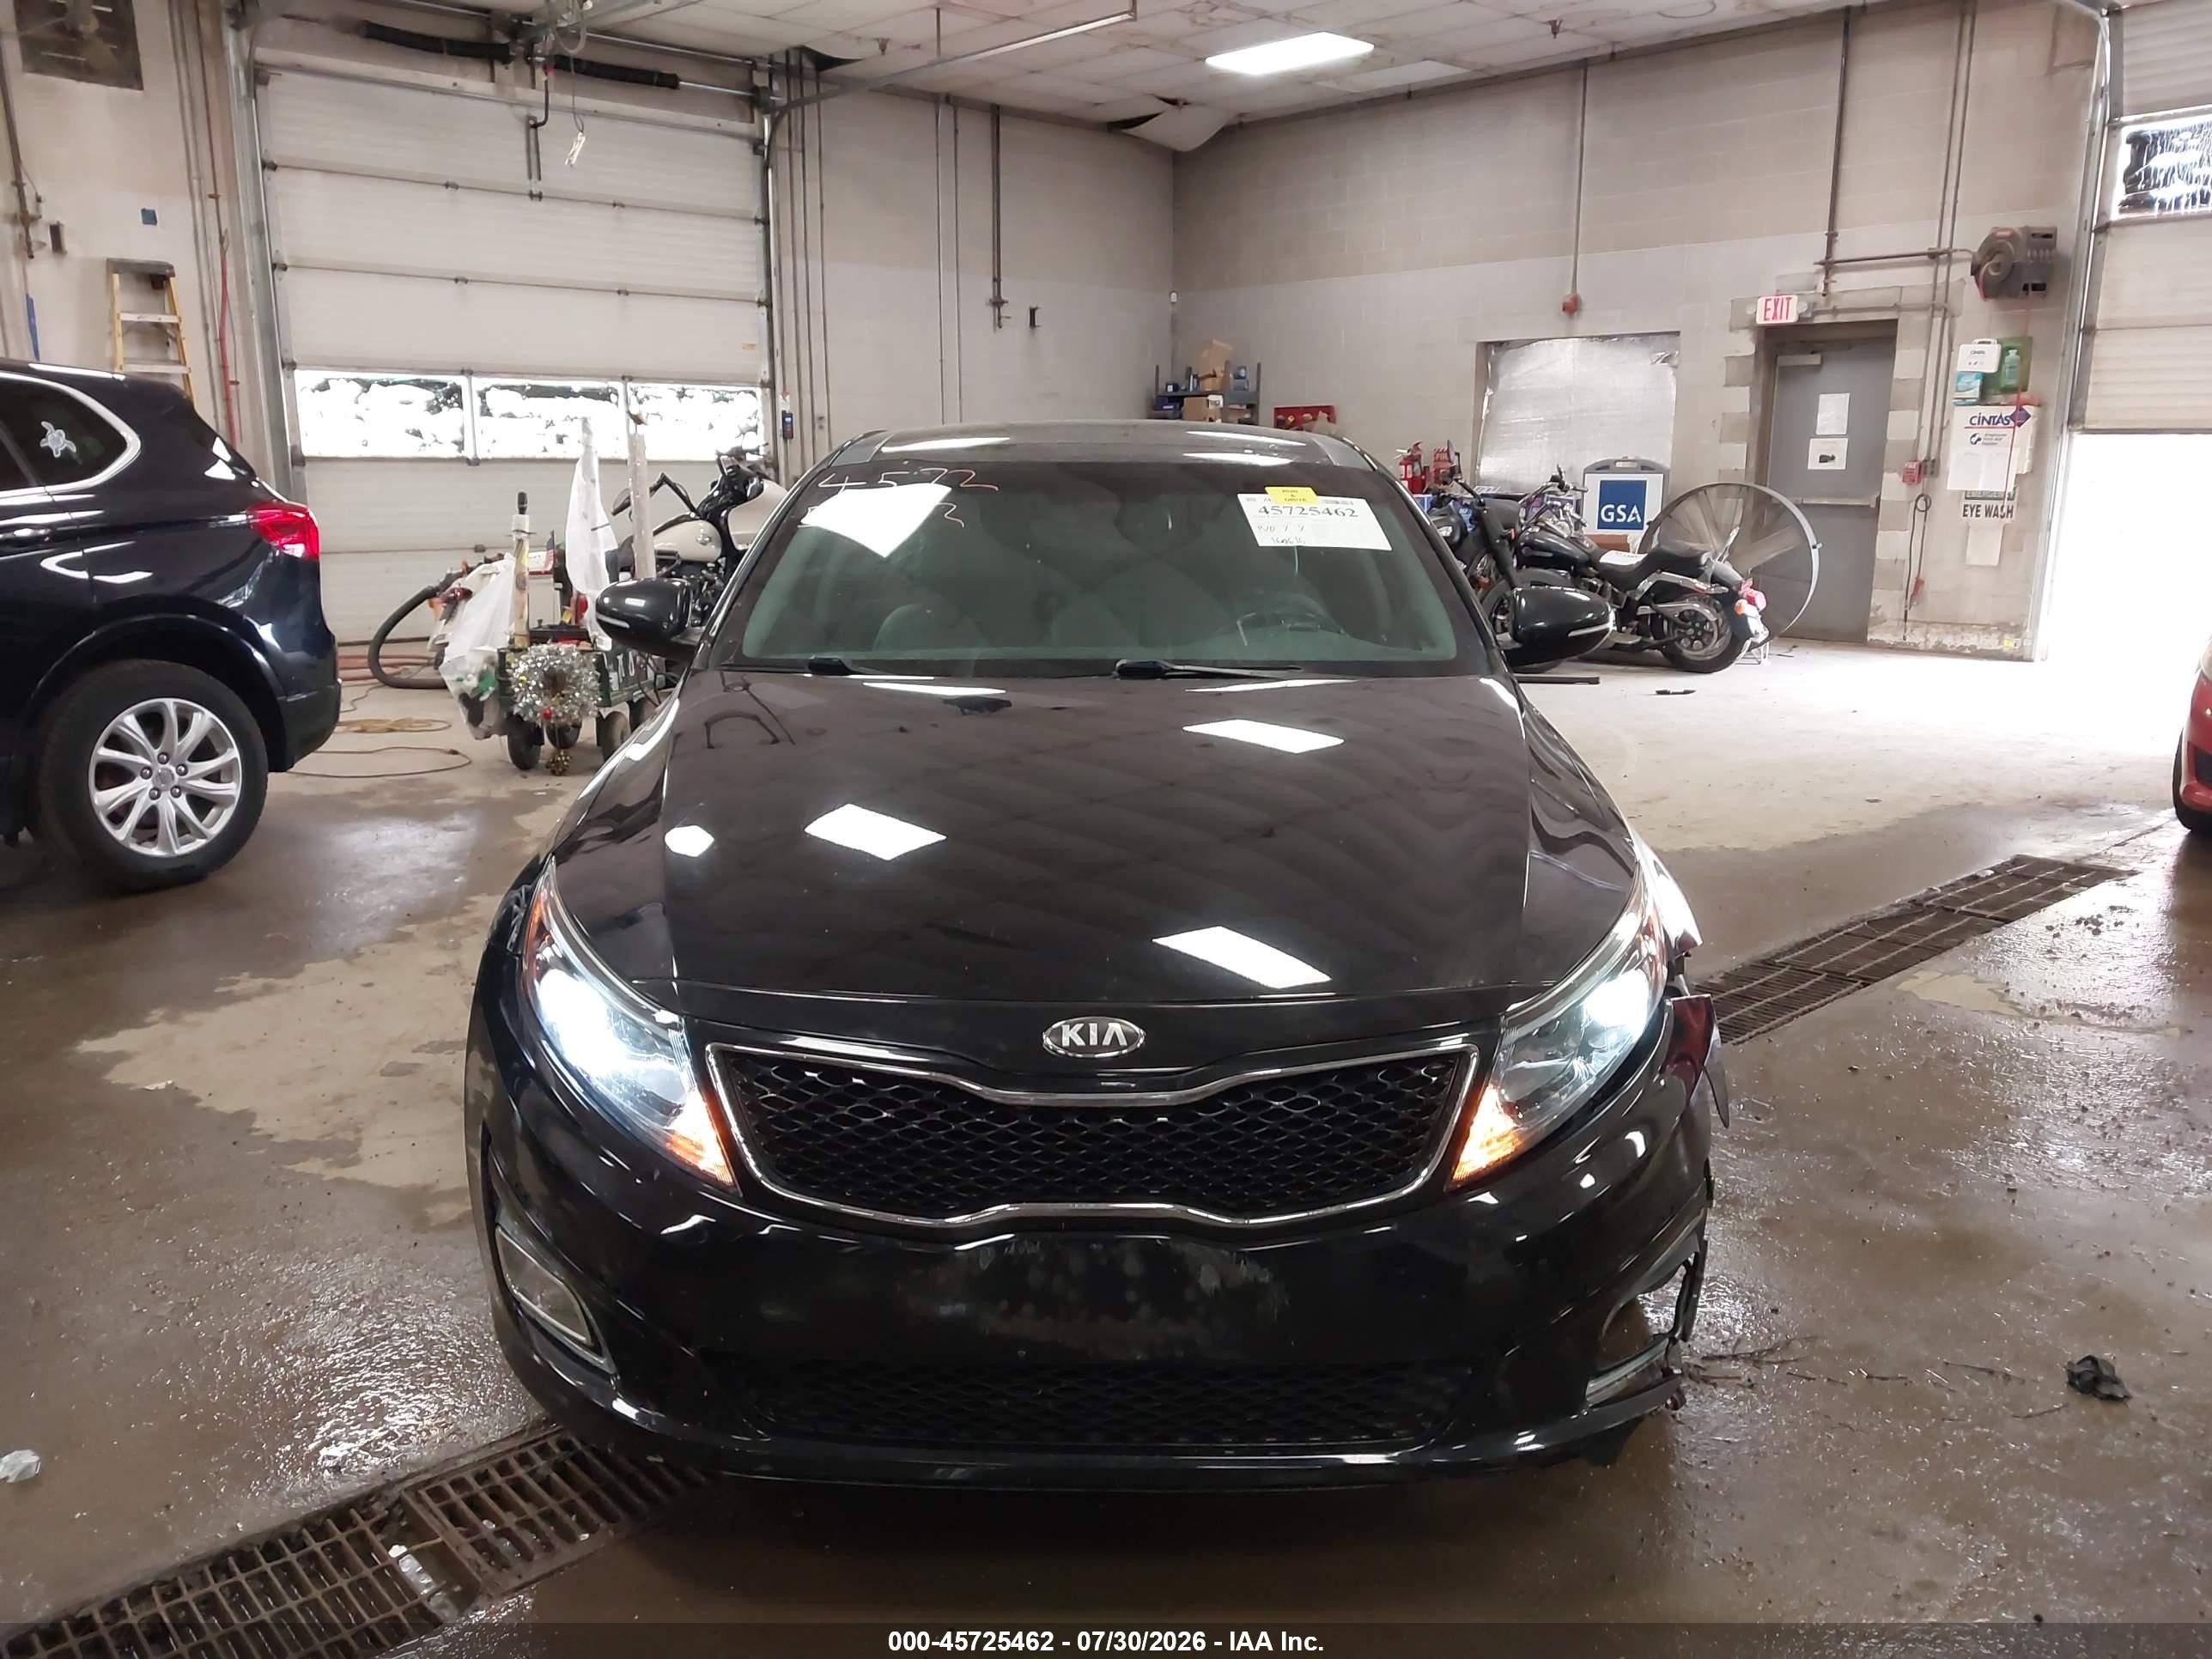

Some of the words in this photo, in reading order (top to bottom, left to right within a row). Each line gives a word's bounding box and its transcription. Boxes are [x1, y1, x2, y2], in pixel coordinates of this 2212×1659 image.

[1764, 297, 1792, 321] EXIT
[1258, 506, 1359, 518] 45725462
[1601, 503, 1642, 523] GSA
[1962, 504, 1982, 518] EYE
[1984, 504, 2014, 519] WASH
[1061, 1022, 1128, 1047] KIA
